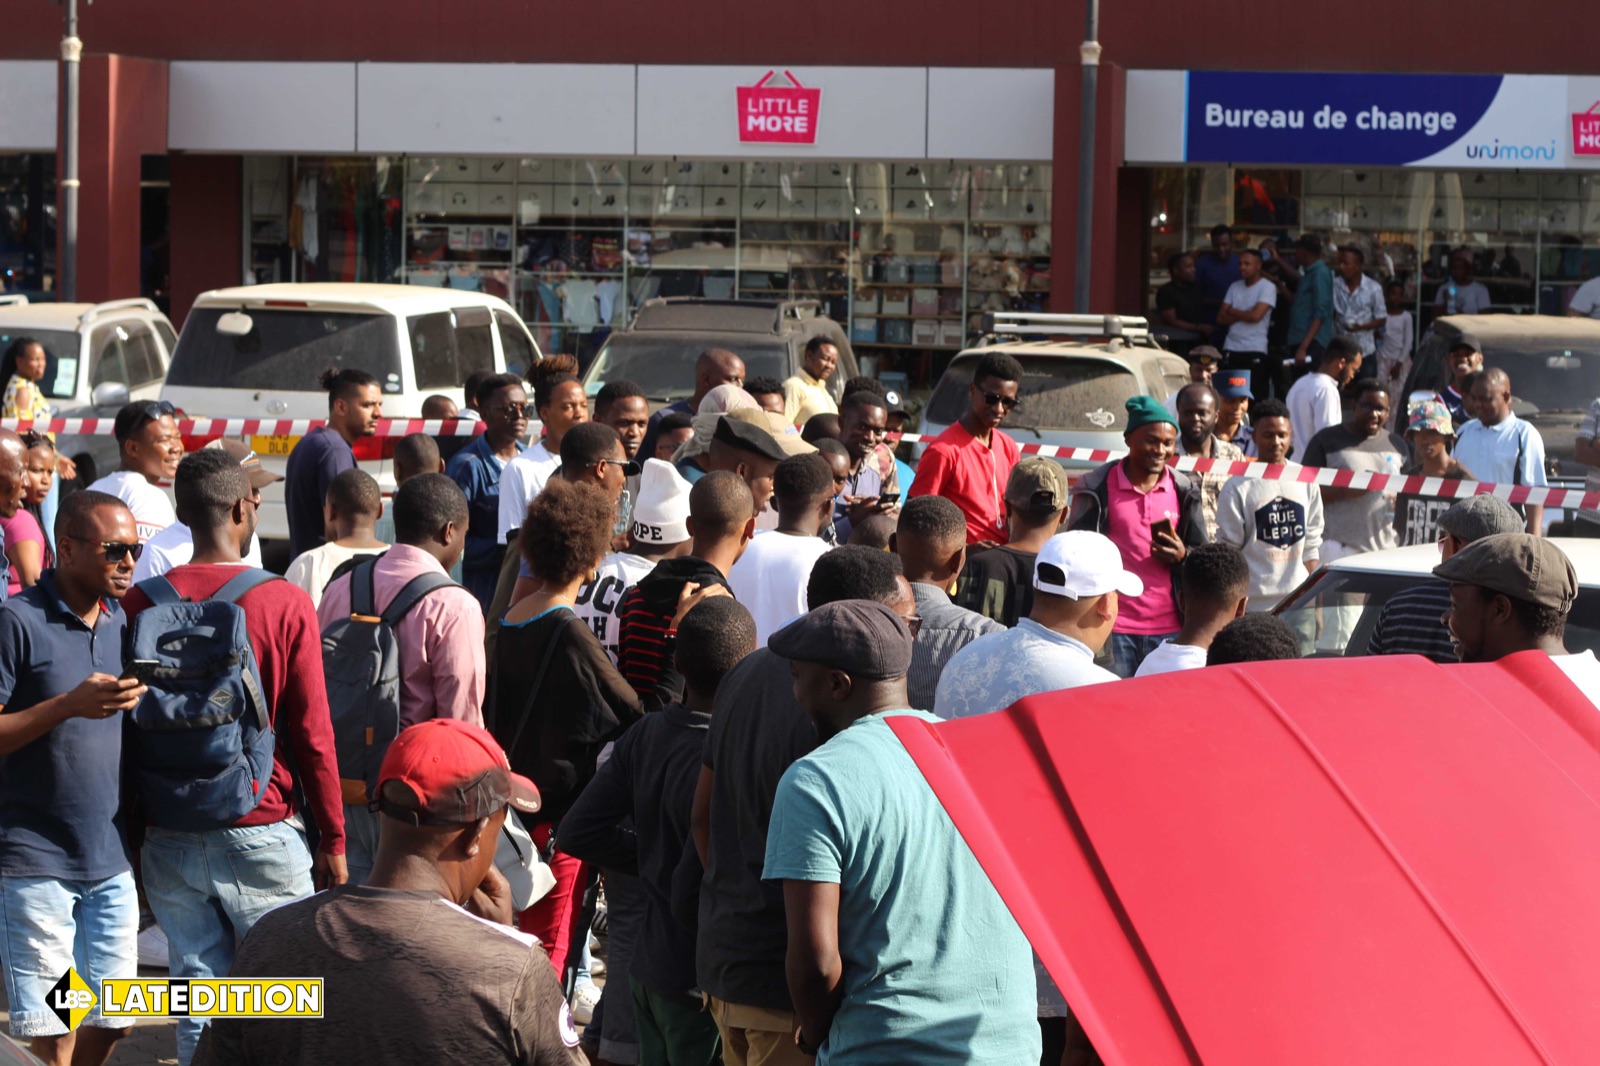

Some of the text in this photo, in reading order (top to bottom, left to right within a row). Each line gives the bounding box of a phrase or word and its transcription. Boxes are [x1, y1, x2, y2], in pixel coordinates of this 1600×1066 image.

[748, 98, 809, 114] LITTLE
[747, 115, 808, 133] MORE
[1205, 103, 1457, 136] Bureau de change
[1466, 138, 1555, 160] unimoni
[1268, 510, 1296, 525] RUE
[1263, 524, 1304, 540] LEPIC
